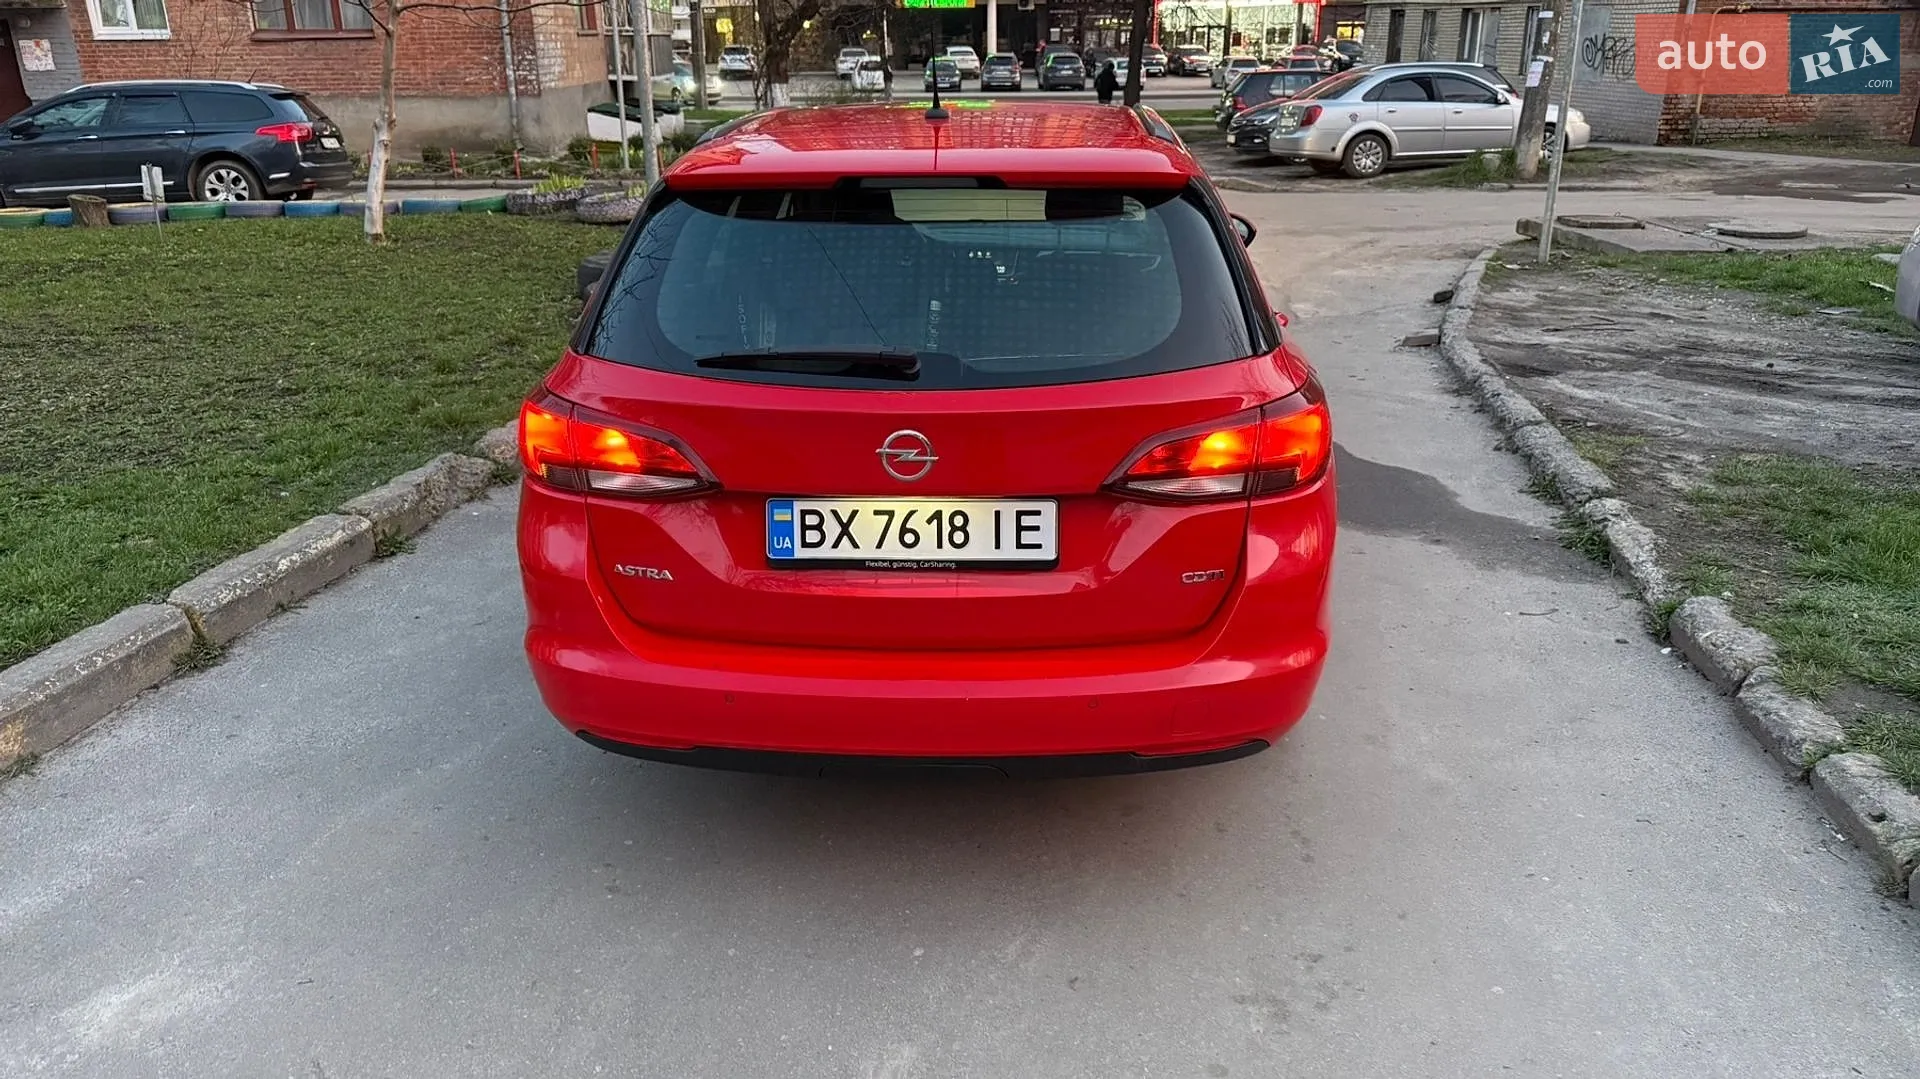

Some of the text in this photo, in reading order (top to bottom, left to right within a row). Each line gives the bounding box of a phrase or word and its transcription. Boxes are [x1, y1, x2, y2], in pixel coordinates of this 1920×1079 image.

[800, 509, 1042, 549] BX 7618 IE
[774, 537, 792, 549] UA
[614, 564, 673, 580] ASTRA
